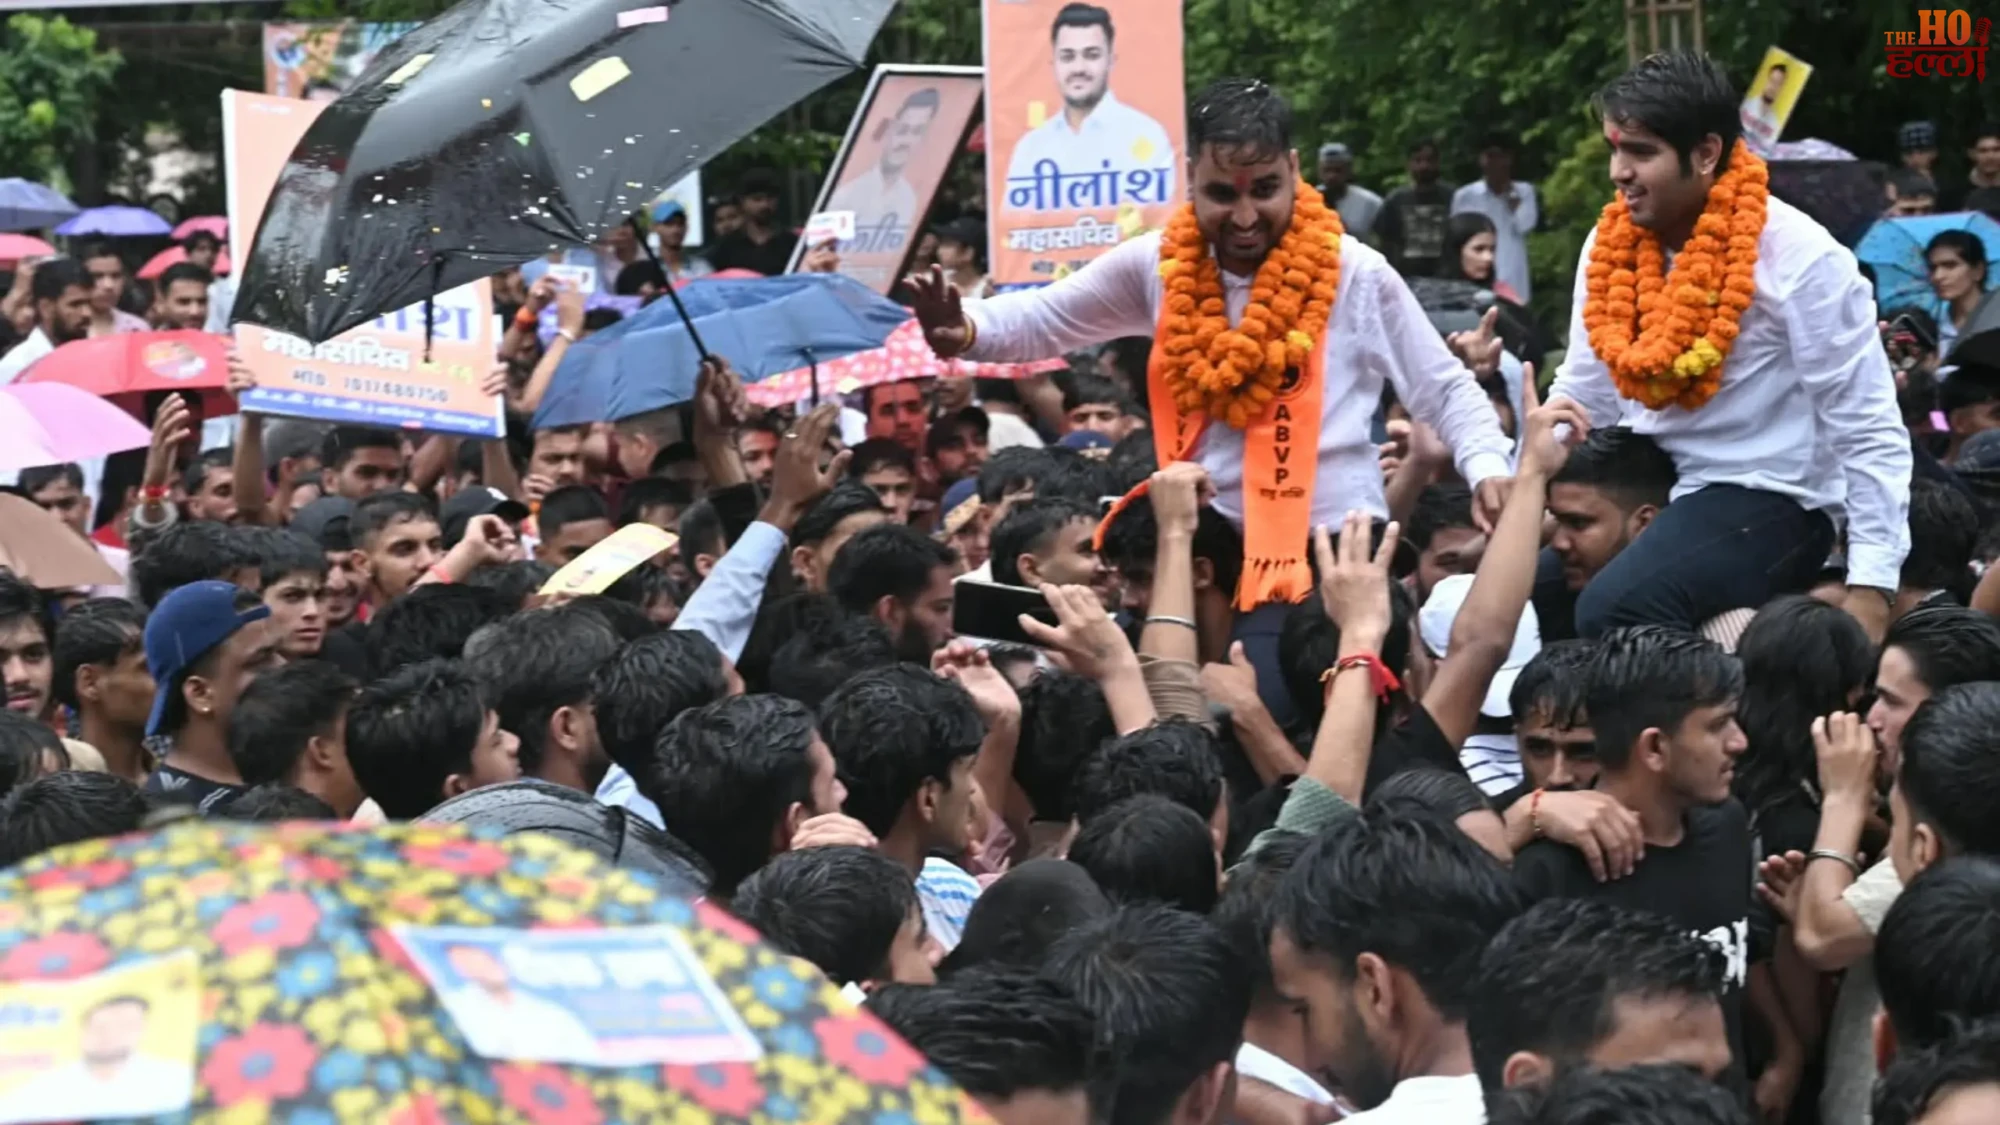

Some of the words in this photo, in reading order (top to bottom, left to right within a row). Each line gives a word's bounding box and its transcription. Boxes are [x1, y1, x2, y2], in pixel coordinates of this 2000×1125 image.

[1007, 158, 1171, 210] नीलांश
[1008, 215, 1121, 253] महासचिव
[1273, 404, 1291, 485] ABVP
